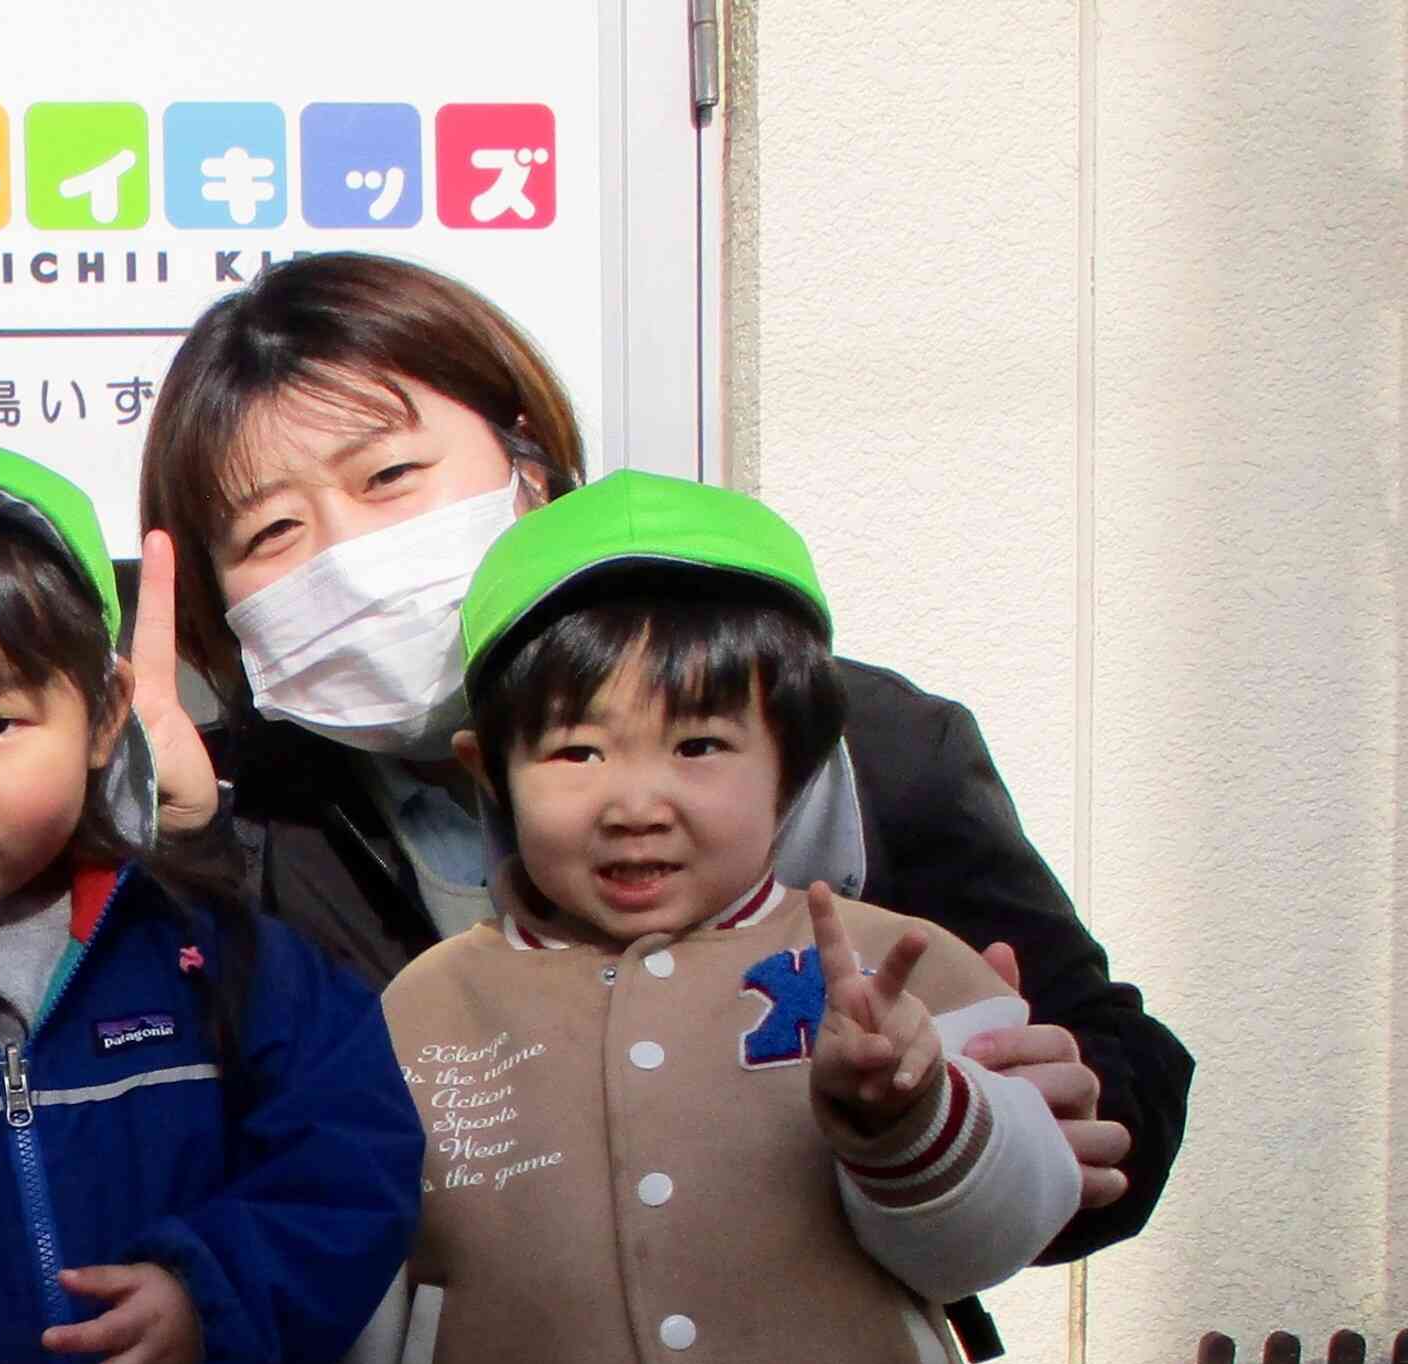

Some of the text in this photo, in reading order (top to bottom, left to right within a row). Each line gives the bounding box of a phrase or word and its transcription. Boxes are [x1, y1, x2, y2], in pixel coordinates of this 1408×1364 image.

[103, 1025, 174, 1048] patagonia
[435, 1067, 476, 1086] the
[484, 1043, 546, 1082] name
[431, 1085, 514, 1109] Action
[432, 1106, 518, 1137] Sports
[439, 1136, 518, 1160] Wear
[446, 1163, 486, 1189] the
[495, 1151, 564, 1191] game
